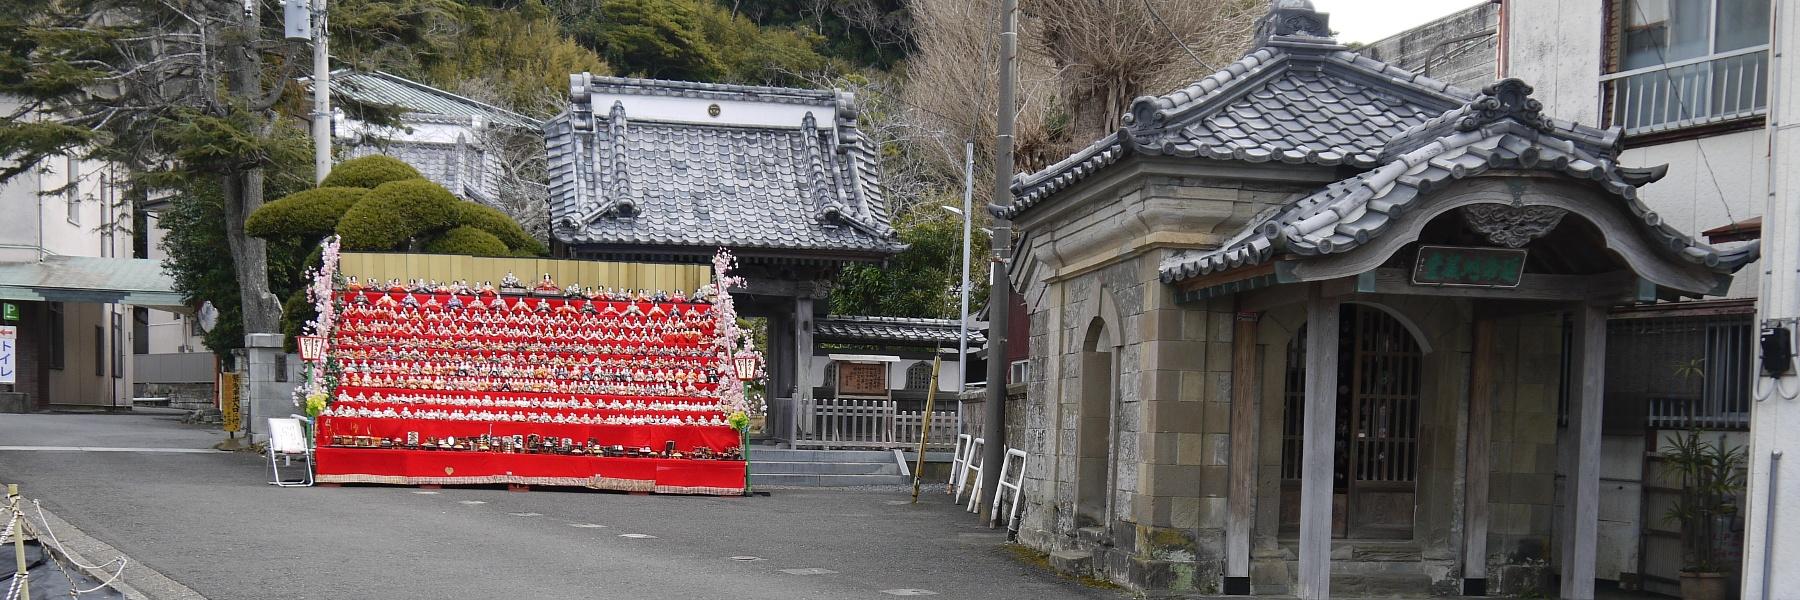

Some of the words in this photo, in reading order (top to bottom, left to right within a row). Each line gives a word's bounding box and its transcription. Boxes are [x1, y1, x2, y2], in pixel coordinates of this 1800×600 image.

[8, 304, 15, 314] P
[0, 341, 13, 376] トイレ
